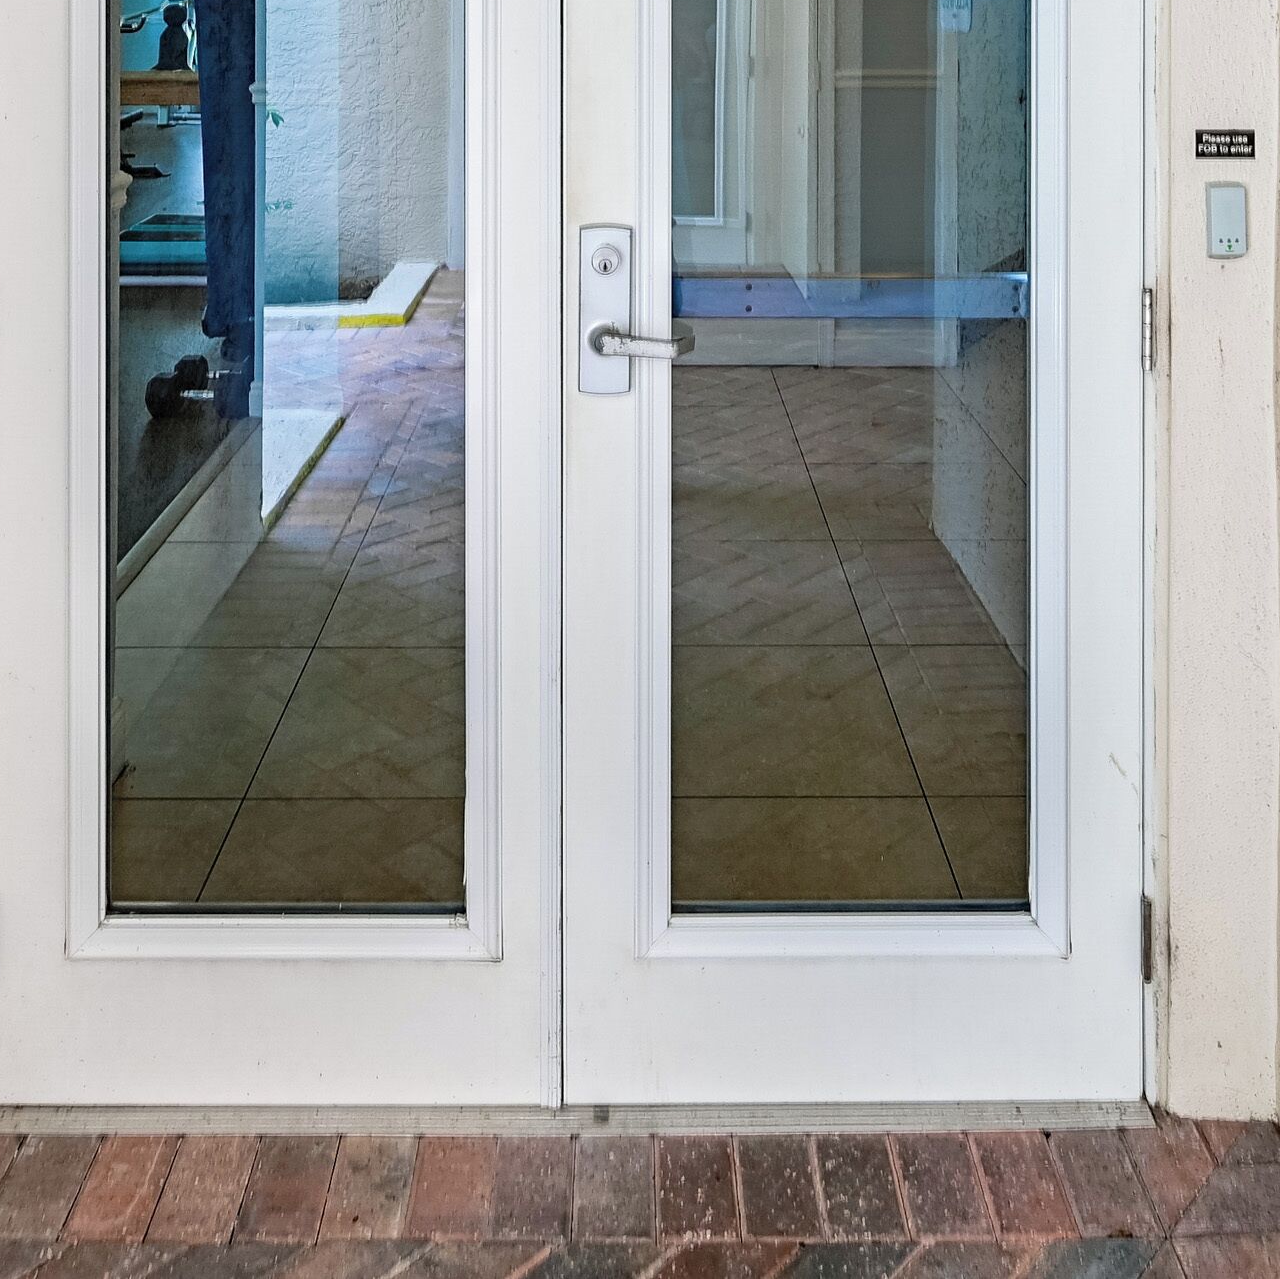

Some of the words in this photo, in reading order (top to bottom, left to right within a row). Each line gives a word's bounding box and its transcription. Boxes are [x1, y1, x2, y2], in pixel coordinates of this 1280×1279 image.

[1203, 134, 1230, 143] Please
[1220, 144, 1228, 154] to
[1230, 144, 1252, 154] enter
